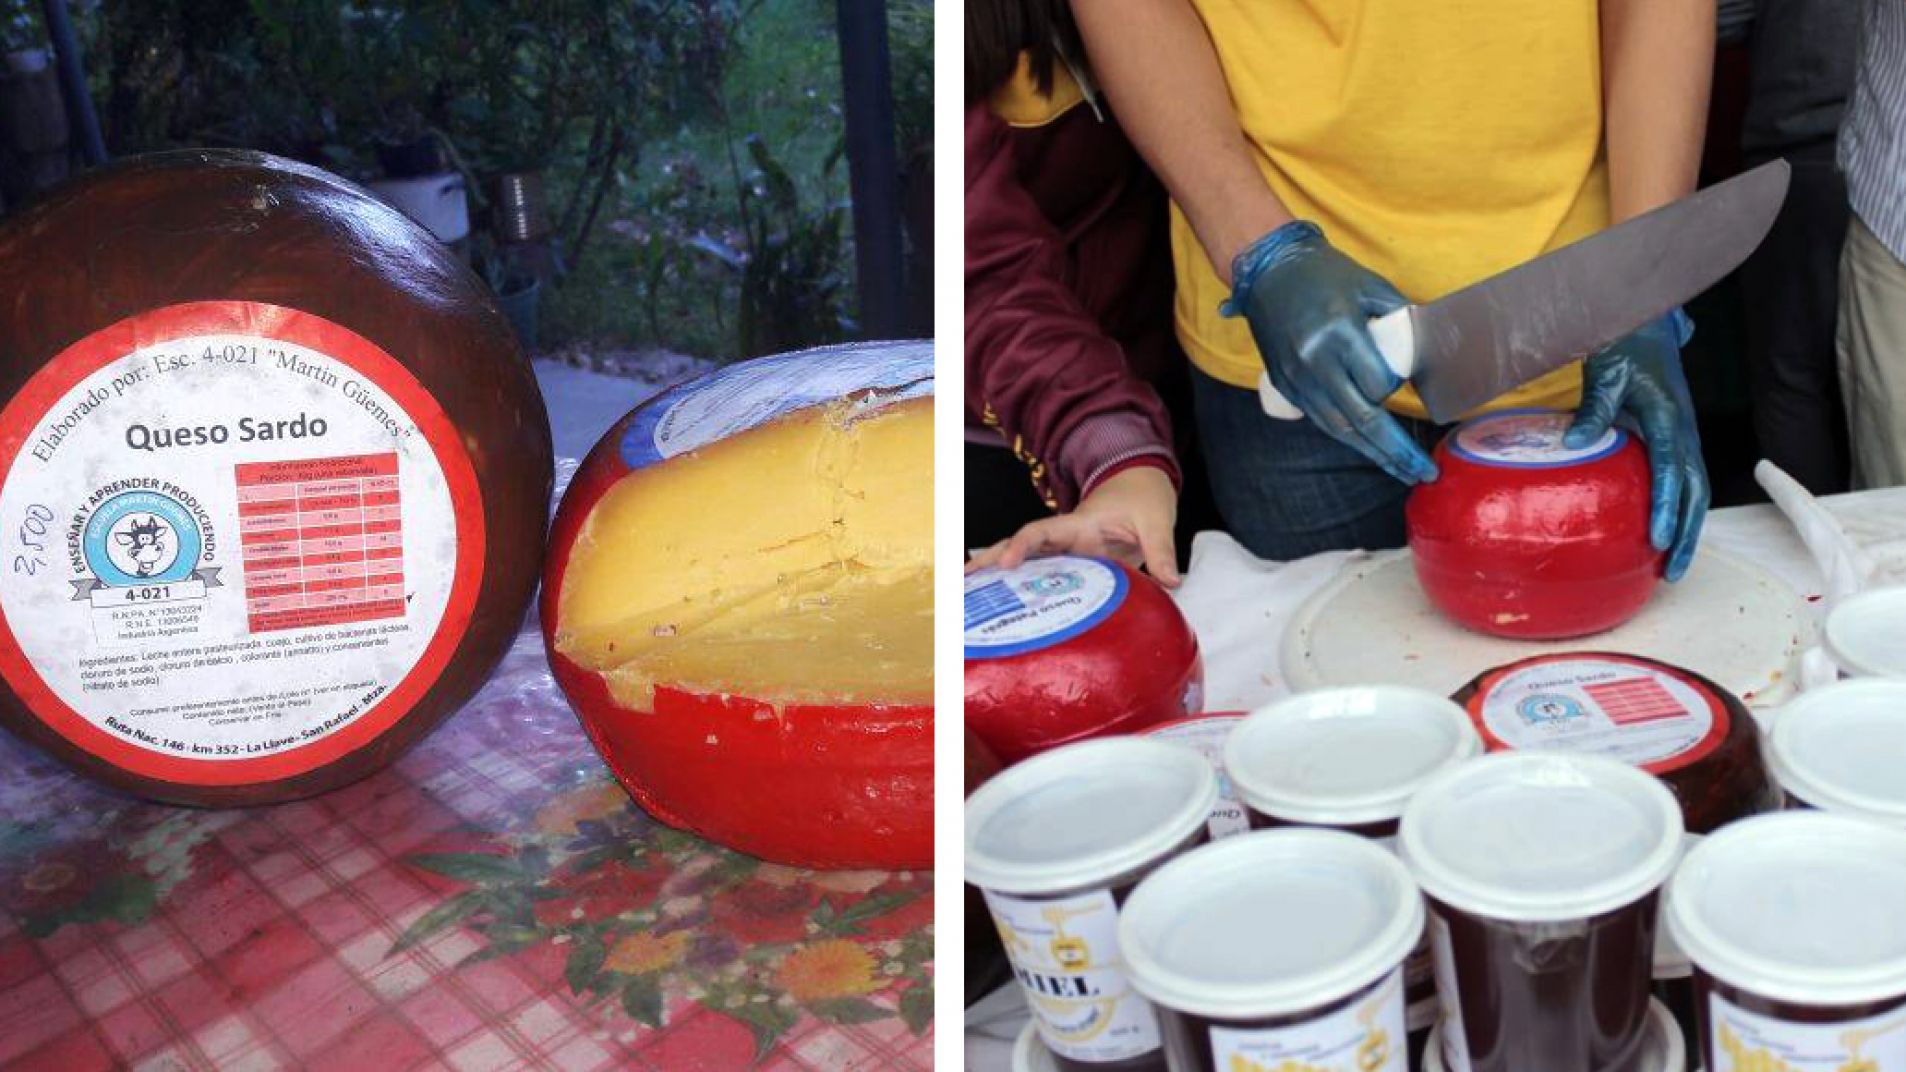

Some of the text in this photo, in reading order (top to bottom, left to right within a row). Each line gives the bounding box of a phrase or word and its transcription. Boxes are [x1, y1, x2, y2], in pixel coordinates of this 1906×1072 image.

[31, 386, 110, 463] Elaborado
[112, 365, 150, 396] por:
[153, 353, 196, 374] Esc.
[202, 345, 257, 365] 4-021
[125, 411, 328, 452] Queso Sardo
[79, 504, 90, 516] Y
[88, 477, 160, 506] APRENDER
[162, 481, 216, 562] PRODUCIENDO
[125, 585, 171, 601] 4-021
[105, 716, 132, 735] Ruta
[161, 738, 185, 752] 146
[191, 743, 213, 754] km
[215, 744, 239, 755] 352
[246, 743, 261, 753] La
[263, 735, 295, 750] Llave
[301, 725, 324, 740] San
[324, 703, 359, 729] Rafael
